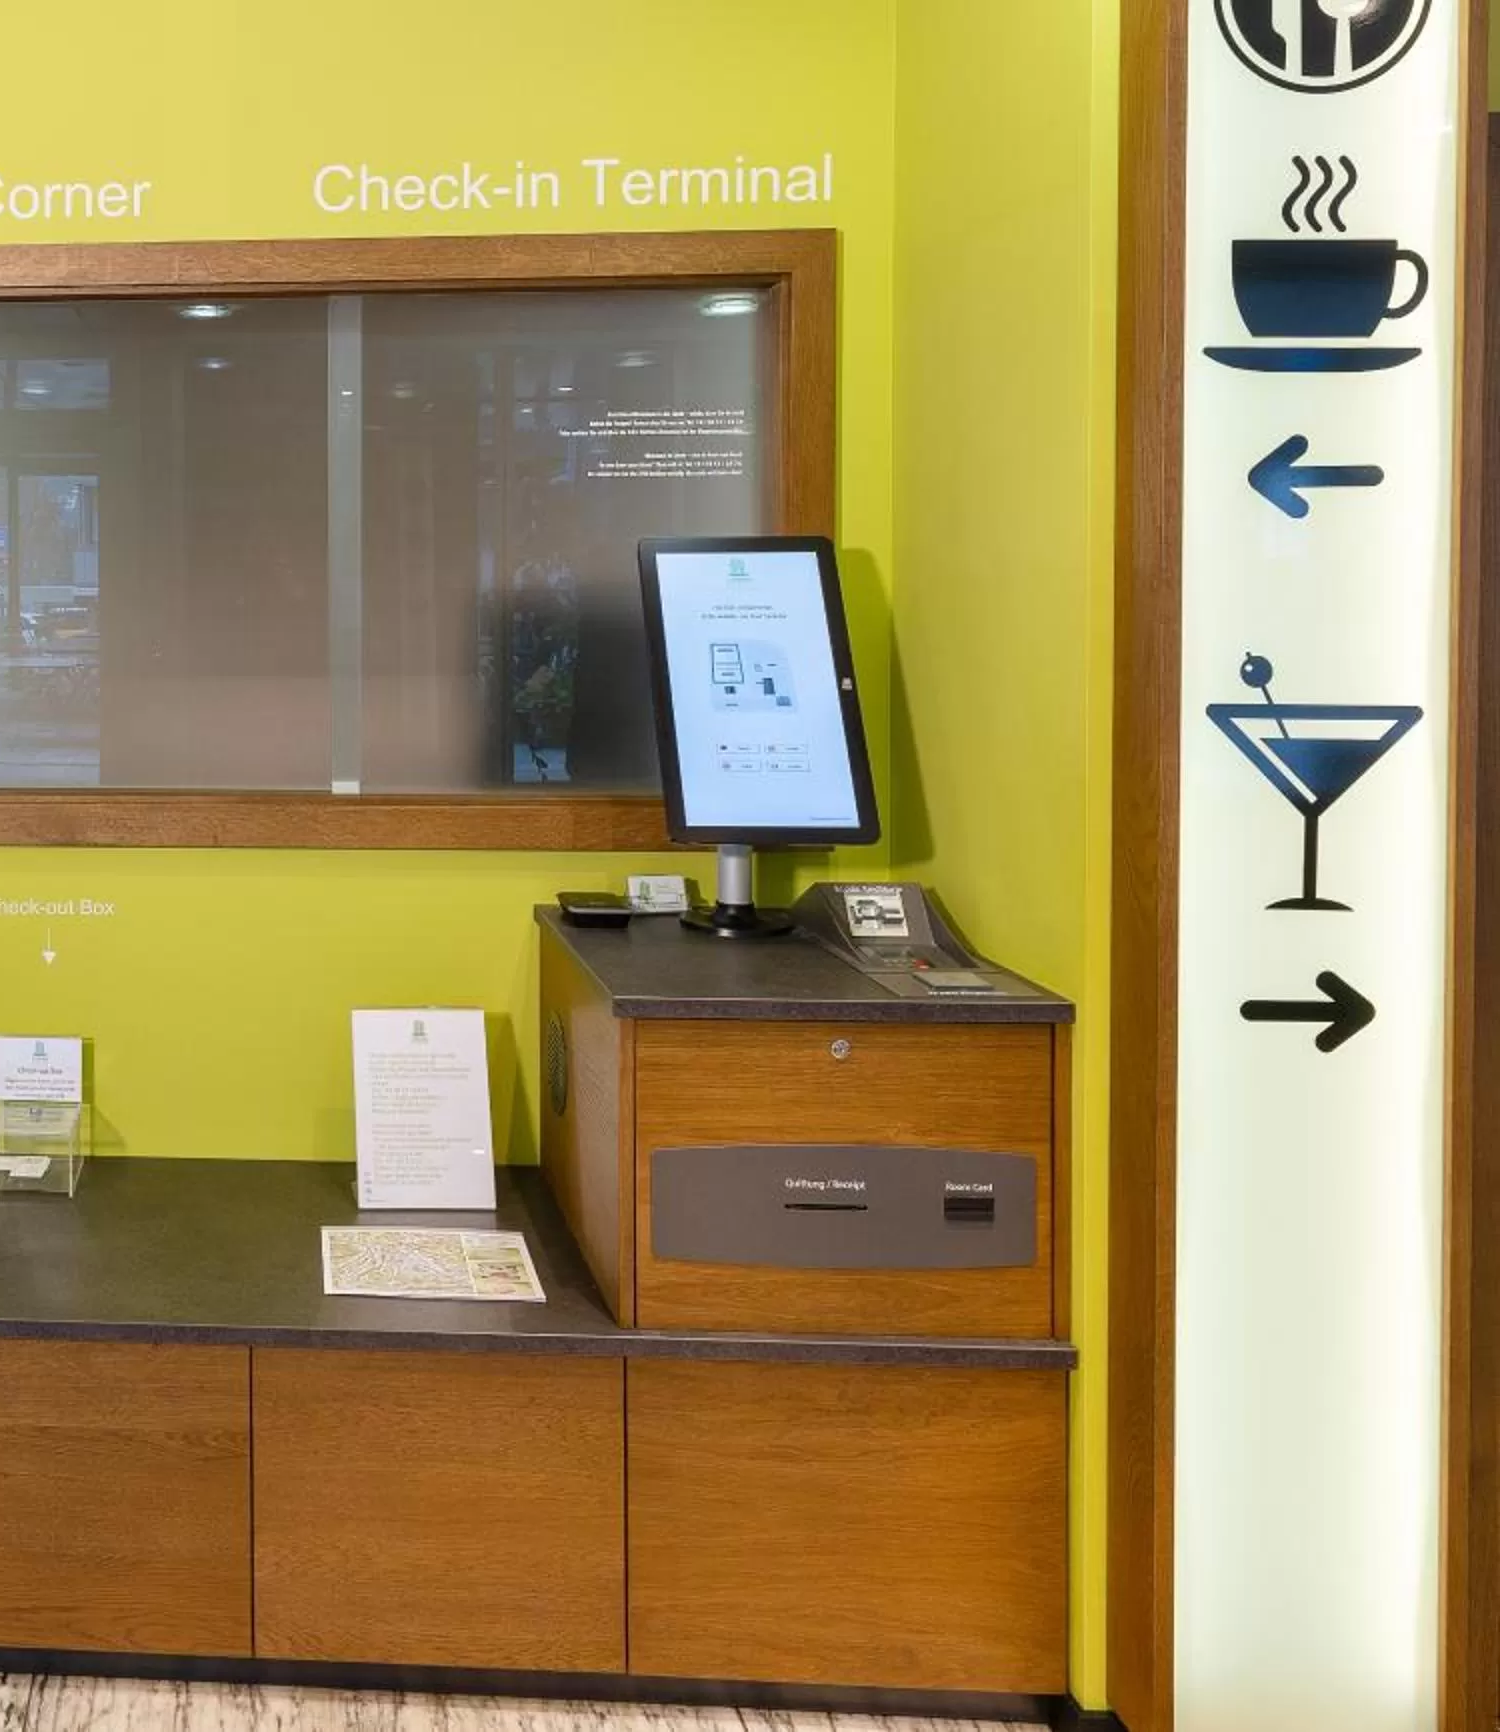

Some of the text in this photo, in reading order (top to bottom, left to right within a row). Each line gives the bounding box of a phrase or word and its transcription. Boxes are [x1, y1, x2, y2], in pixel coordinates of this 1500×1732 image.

[313, 153, 832, 213] Check-in Terminal
[79, 898, 115, 915] Box
